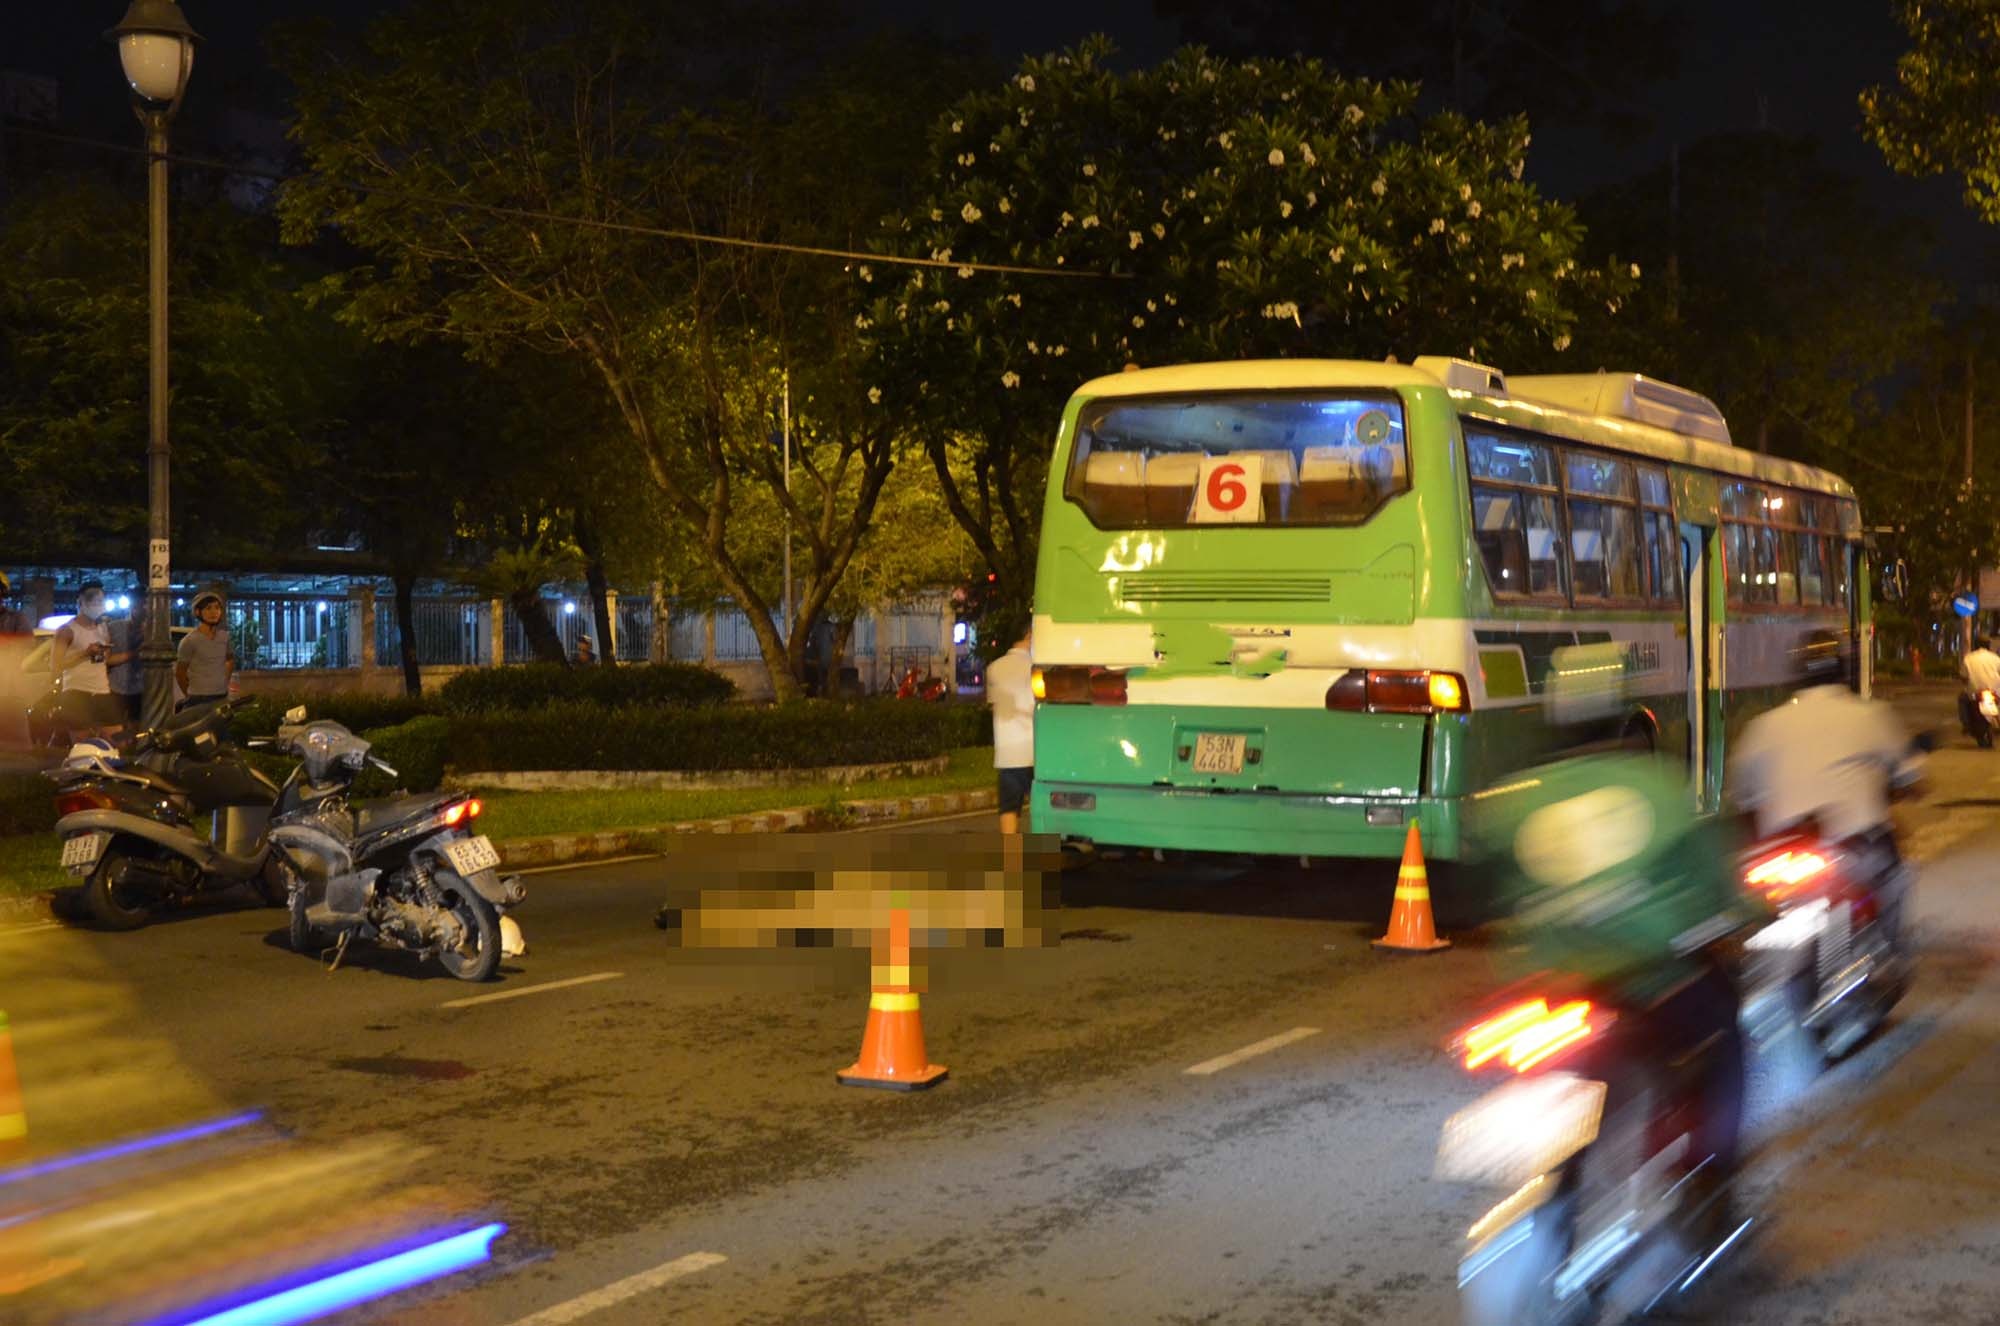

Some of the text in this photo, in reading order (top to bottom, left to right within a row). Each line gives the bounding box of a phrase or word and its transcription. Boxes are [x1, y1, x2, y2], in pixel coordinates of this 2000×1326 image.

[1206, 464, 1247, 513] 6
[1205, 735, 1236, 753] 53N
[1199, 753, 1235, 769] 4461
